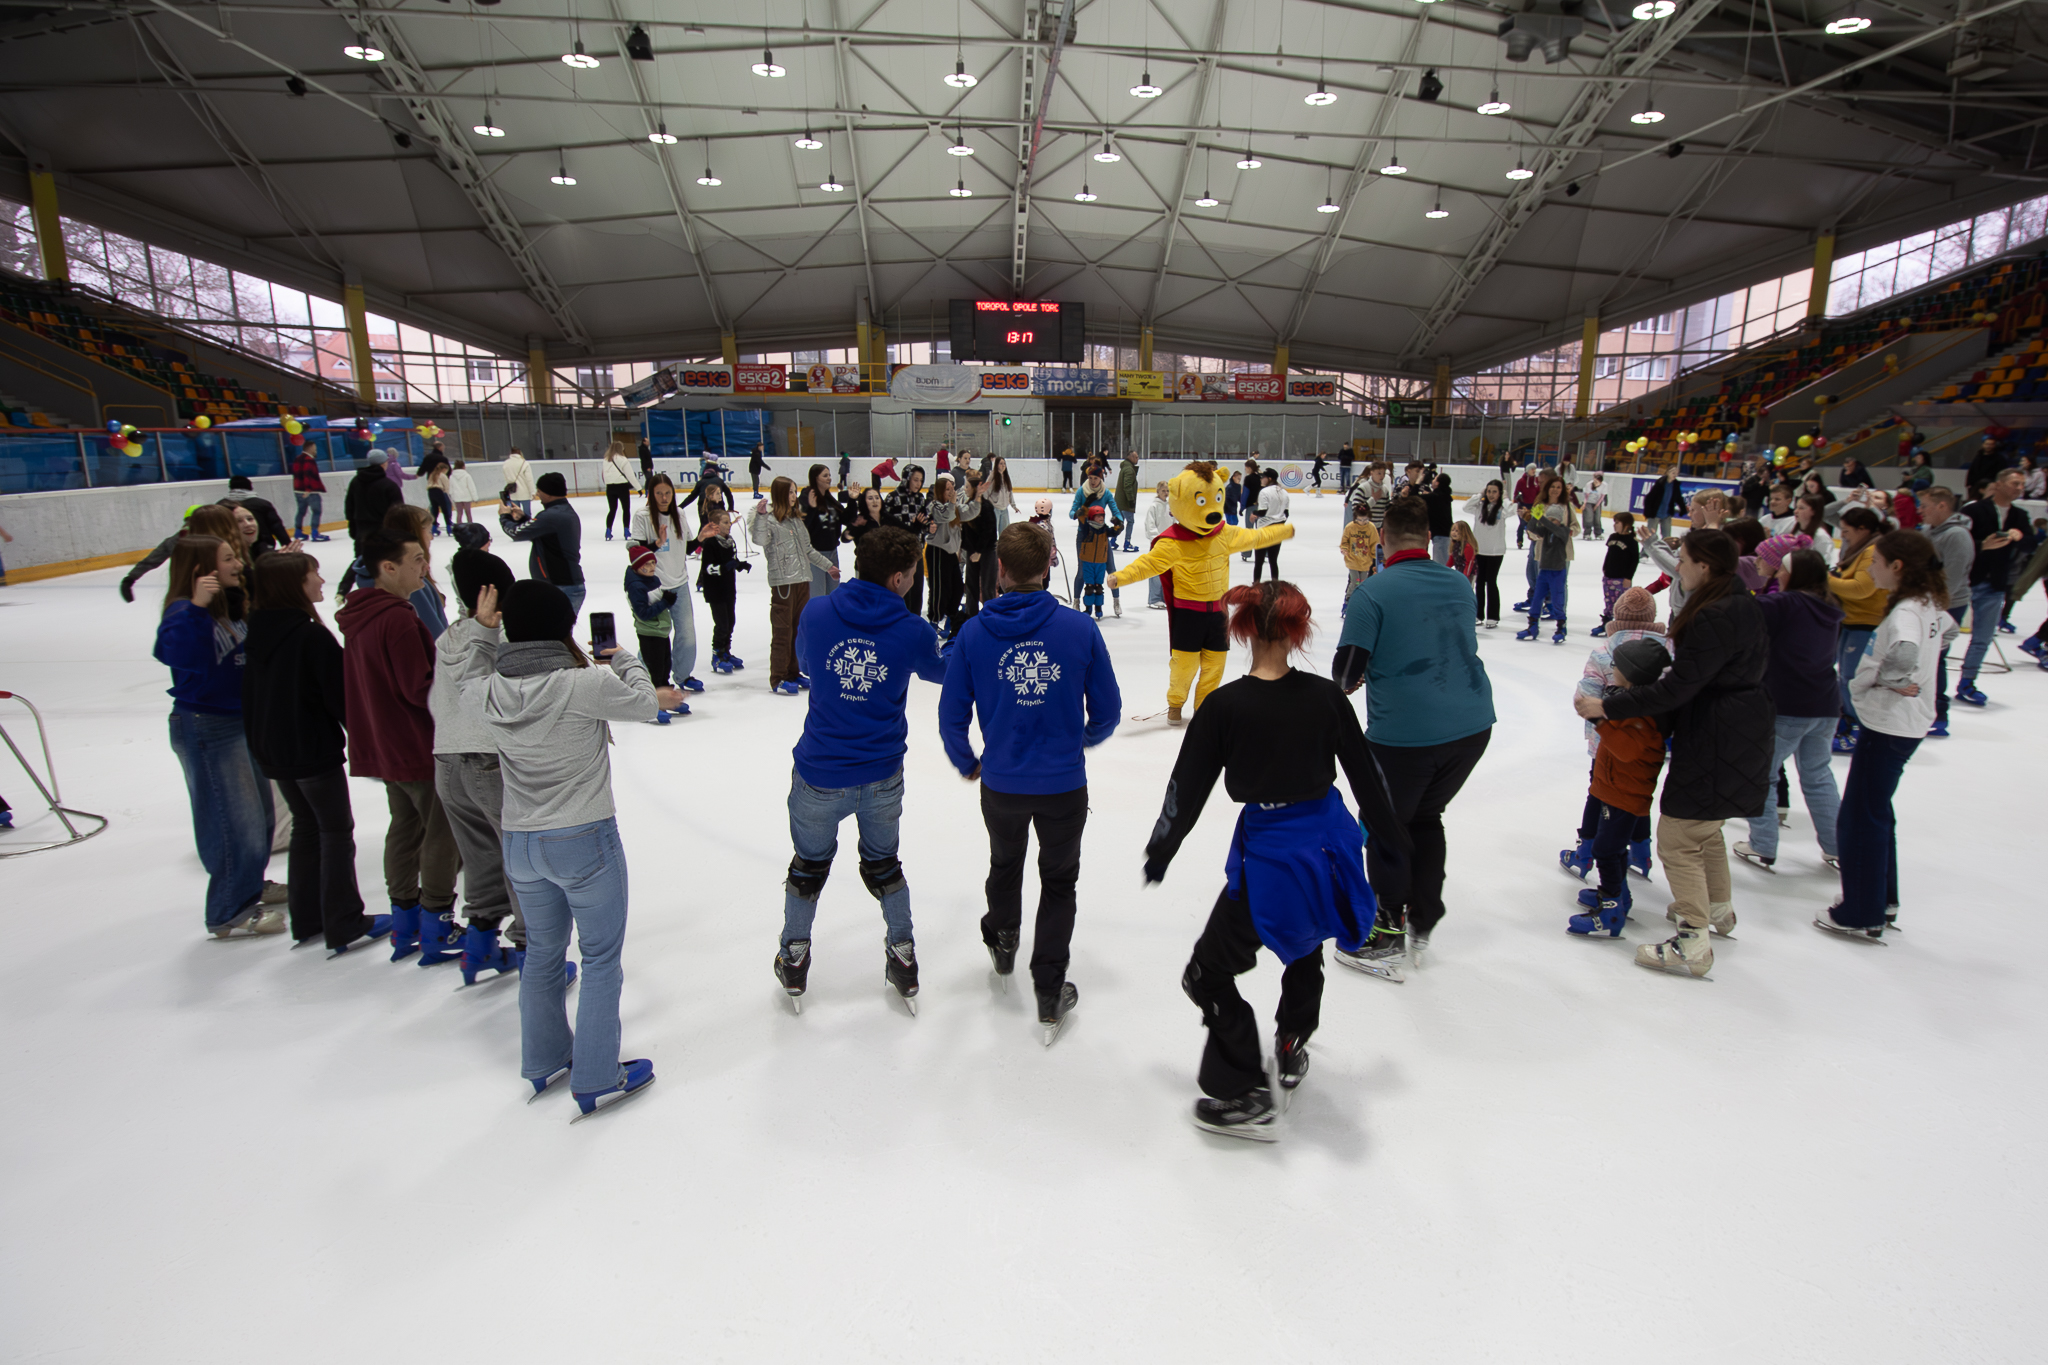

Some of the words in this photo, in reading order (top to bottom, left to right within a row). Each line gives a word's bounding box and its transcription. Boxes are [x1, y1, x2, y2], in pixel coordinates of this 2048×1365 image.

[976, 301, 1010, 311] TOROPOL
[1012, 302, 1038, 312] OPOLE
[1006, 331, 1033, 344] 13:17
[684, 371, 731, 387] eska
[983, 374, 1028, 389] eska
[1047, 374, 1093, 394] mosir
[1292, 381, 1334, 396] eska
[1305, 471, 1342, 481] OOLE
[828, 640, 845, 658] CREW
[998, 647, 1014, 667] CREW
[840, 692, 868, 702] KAMIL
[1016, 698, 1045, 707] KAMIL
